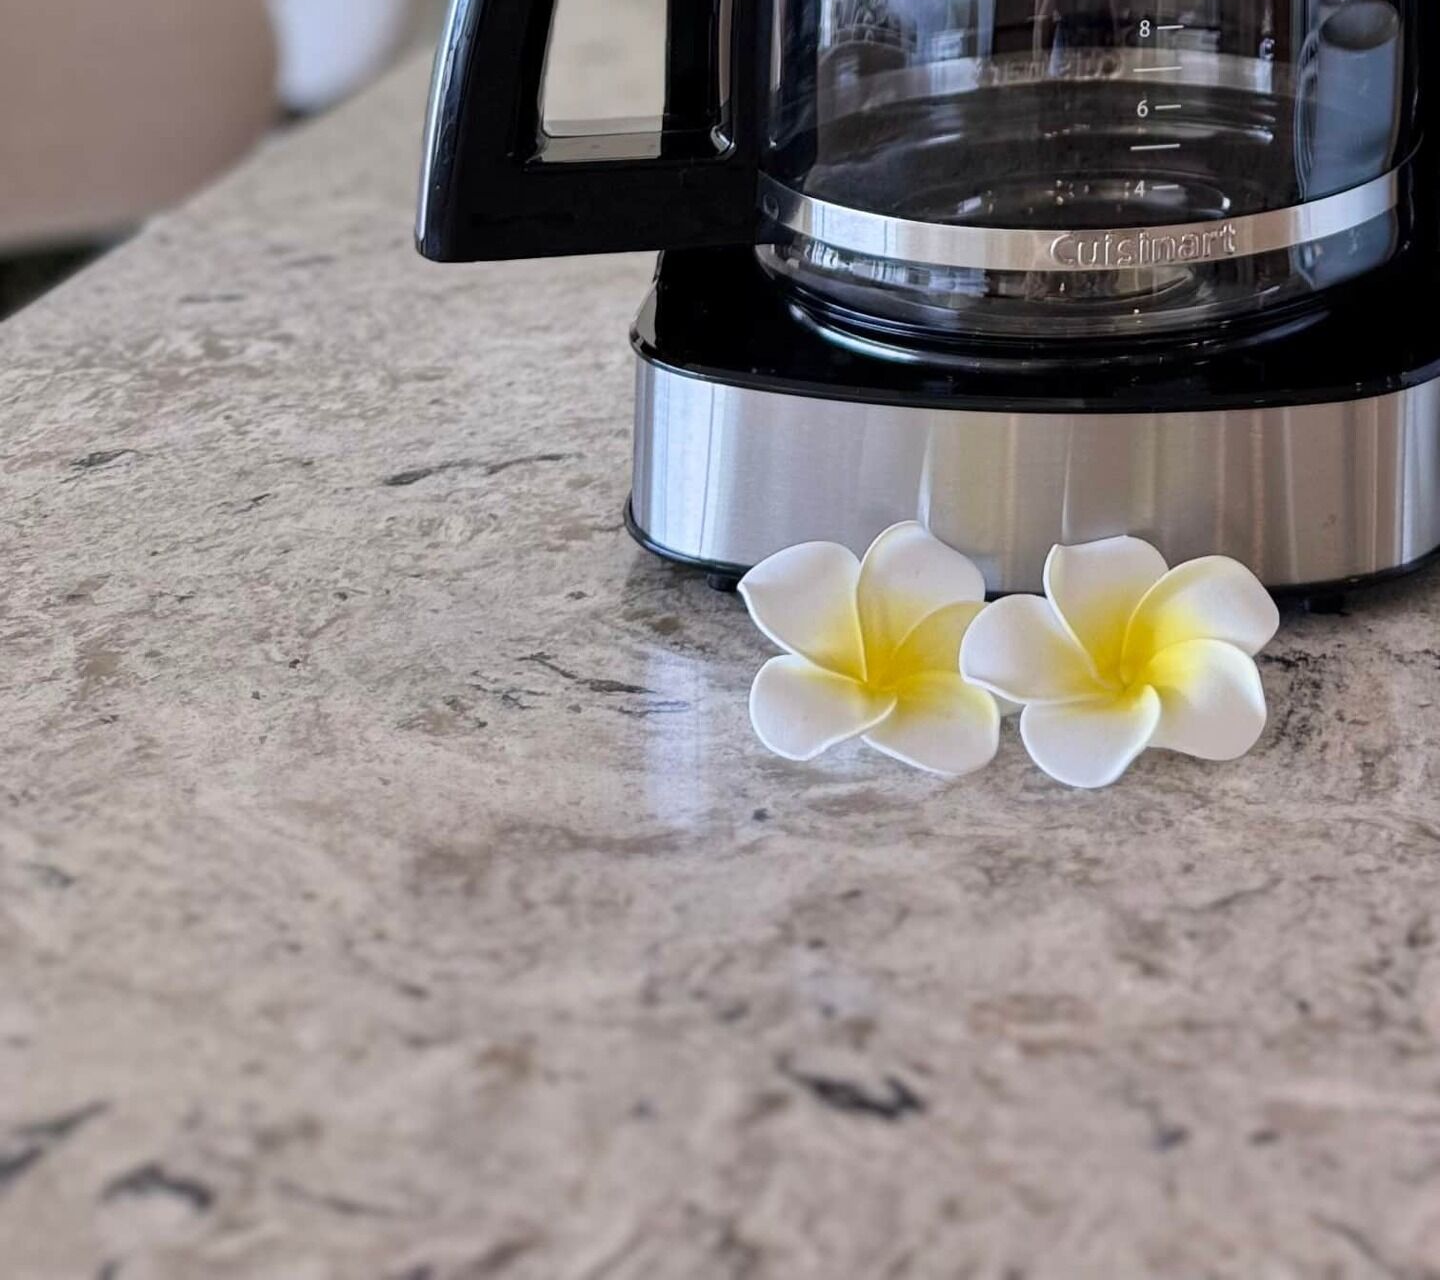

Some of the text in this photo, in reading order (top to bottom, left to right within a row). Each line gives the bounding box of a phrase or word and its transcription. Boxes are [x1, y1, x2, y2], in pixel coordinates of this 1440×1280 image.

[1139, 19, 1151, 38] 8
[1136, 99, 1149, 118] 6
[1133, 180, 1146, 198] 4
[1050, 223, 1236, 266] Cuisinart
